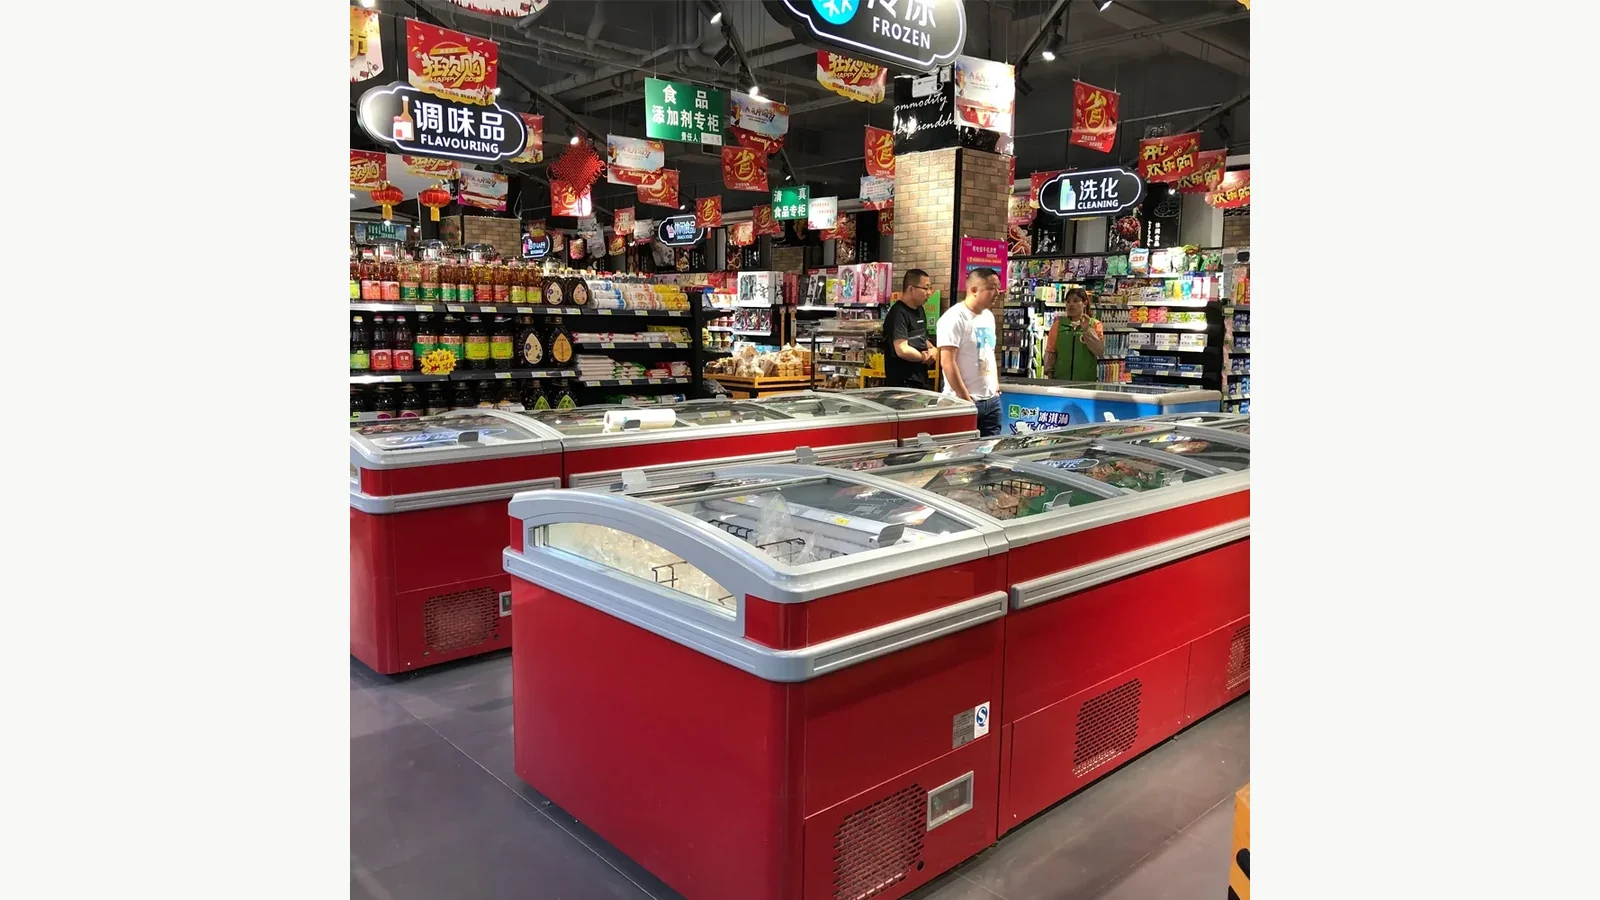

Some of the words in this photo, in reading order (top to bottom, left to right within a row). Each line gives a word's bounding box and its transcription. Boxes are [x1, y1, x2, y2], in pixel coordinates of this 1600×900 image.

[873, 16, 930, 49] FROZEN
[421, 51, 486, 87] 狂欢购
[662, 84, 708, 110] 食品
[1087, 90, 1107, 124] 省
[414, 100, 505, 142] 调味品
[652, 105, 719, 132] 添加剂专柜
[420, 133, 499, 154] FLAVOURING
[733, 149, 755, 176] 省
[1146, 153, 1194, 178] 欢乐购
[1079, 177, 1119, 201] 洗化
[1176, 169, 1220, 190] 欢乐购
[774, 187, 806, 203] 清真
[1078, 198, 1119, 210] CLEANING
[774, 203, 806, 219] 食品专柜
